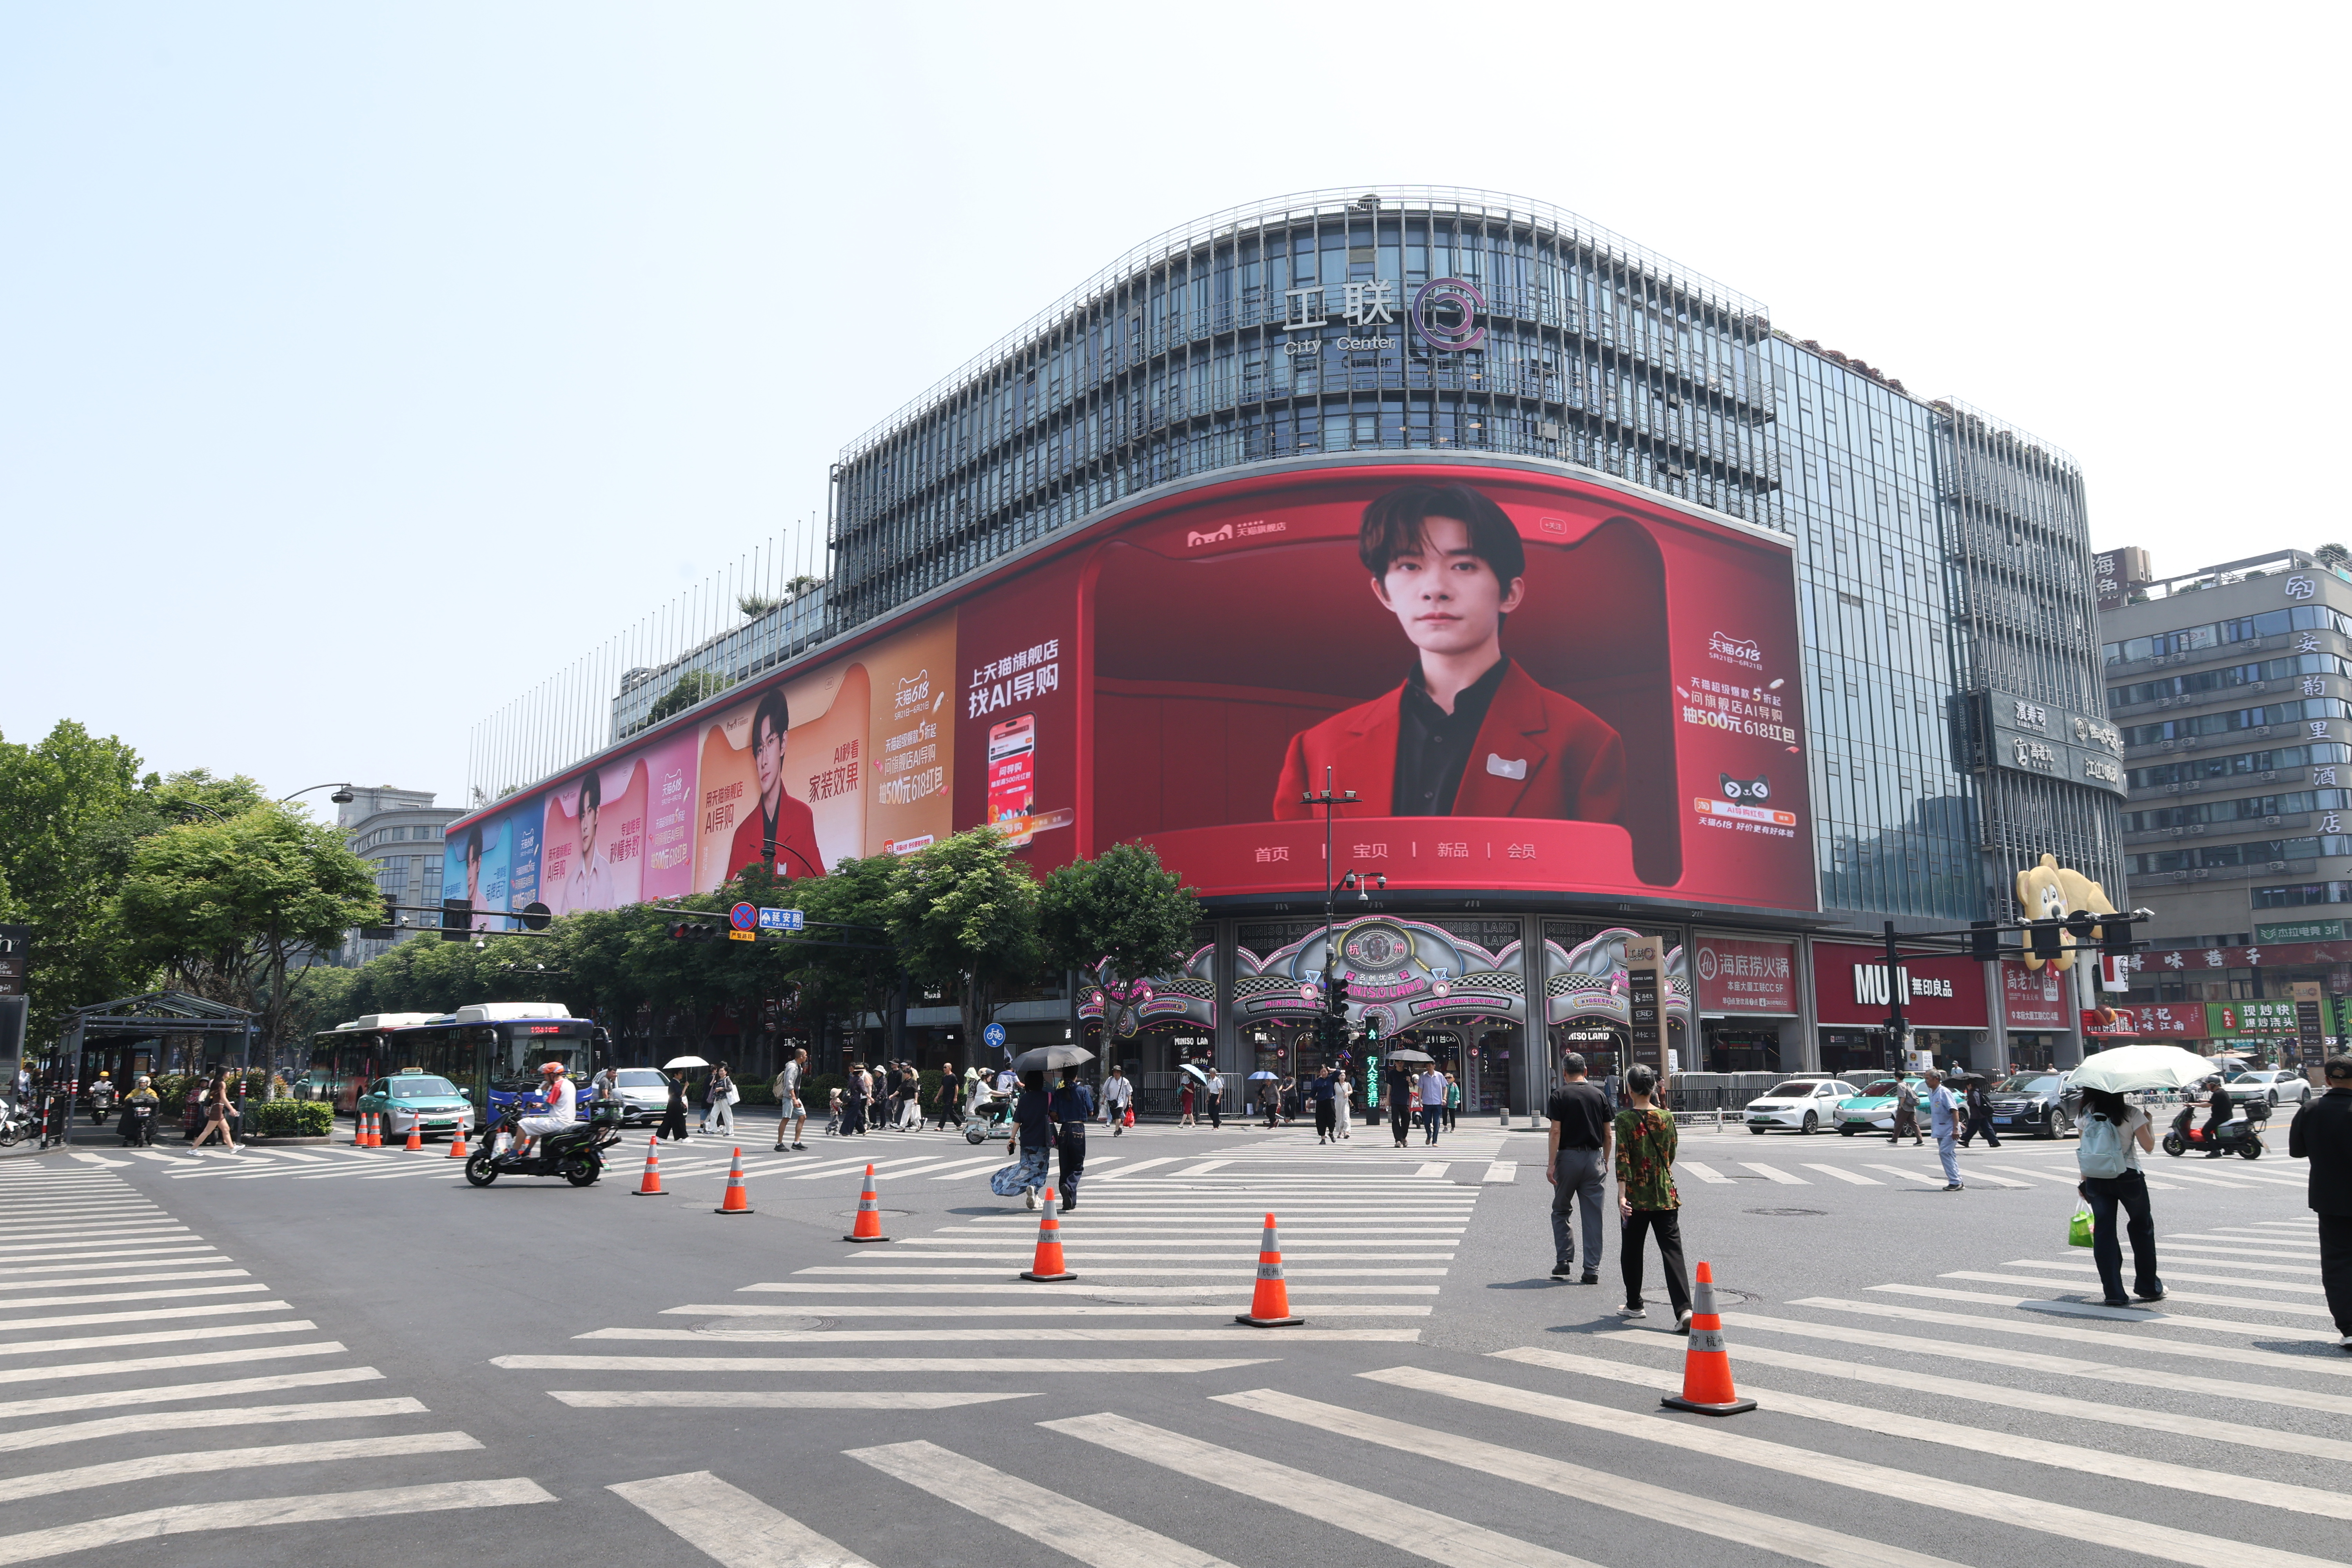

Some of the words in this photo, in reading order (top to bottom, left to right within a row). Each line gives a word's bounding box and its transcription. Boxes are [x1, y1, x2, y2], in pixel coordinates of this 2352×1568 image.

[1282, 279, 1394, 331] 工联
[1284, 339, 1322, 356] City
[1337, 336, 1395, 351] Center
[1709, 638, 1761, 661] 天猫618
[969, 639, 1058, 688] 上天猫旗舰店
[895, 681, 929, 709] 天猫618
[969, 663, 1058, 719] 找AI导购
[1691, 691, 1783, 722] 问旗舰店AI导购
[834, 739, 858, 764] AI秒看
[884, 743, 936, 777] 问旗舰店AI导购
[2029, 741, 2054, 762] 高老九
[662, 777, 682, 797] 天猫618
[809, 762, 858, 803] 家装效果
[706, 781, 743, 808] 用天猫旗舰店
[705, 804, 734, 834] AI导购
[1727, 807, 1765, 818] AI导购红包
[621, 817, 641, 837] 专业推荐
[1699, 817, 1733, 829] 天猫618
[1736, 822, 1794, 837] 好价更有好体验
[610, 835, 640, 864] 秒懂参数
[1255, 847, 1289, 862] 首页
[1353, 843, 1388, 858] 宝贝
[1437, 842, 1468, 858] 新品
[1507, 843, 1536, 859] 会员
[547, 859, 566, 883] AI导购
[772, 912, 801, 924] 延安路
[1484, 923, 1515, 933] LAND
[1191, 929, 1212, 939] AND
[1242, 925, 1283, 936] MINISO
[1547, 923, 1583, 934] MINISO
[2278, 926, 2321, 938] 杰拉电竞
[2325, 926, 2338, 935] 3F
[1348, 944, 1359, 955] 杭
[1394, 942, 1404, 954] 州
[1719, 953, 1789, 978] 海底捞火锅
[2127, 947, 2261, 971] 寻味巷子
[1359, 973, 1395, 982] 名创优品
[1728, 981, 1774, 992] 本座大厦工联CC
[1776, 984, 1783, 992] 5F
[1912, 977, 1953, 997] 無印良品
[2007, 969, 2039, 990] 高老九
[1341, 984, 1386, 998] INISO
[1389, 979, 1424, 998] LAND
[1265, 1000, 1298, 1008] MINISO
[2141, 1007, 2172, 1021] 吴记
[2016, 1011, 2050, 1020] 本座大厦工联CC
[2051, 1012, 2058, 1020] 4层
[1174, 1037, 1194, 1045] MINISO
[1367, 1056, 1378, 1107] 行人安全通行
